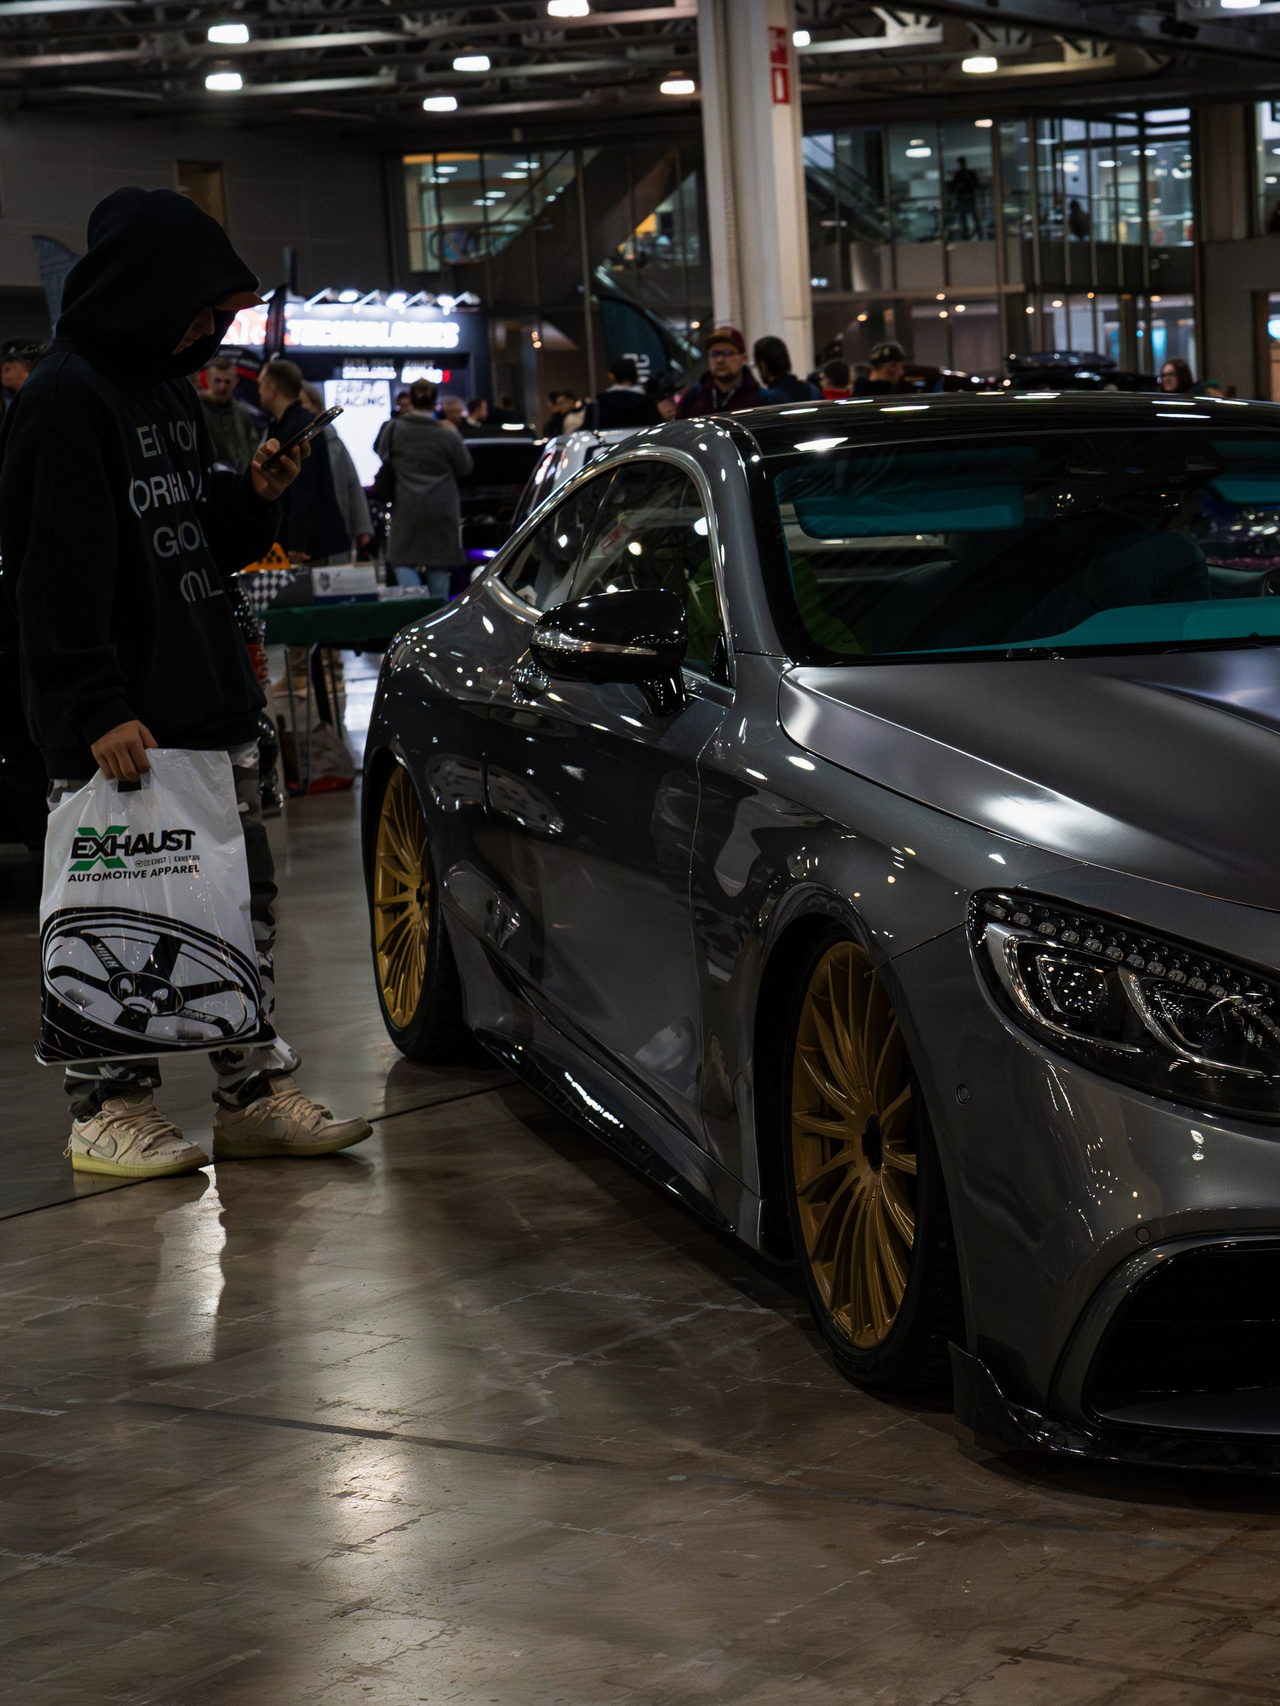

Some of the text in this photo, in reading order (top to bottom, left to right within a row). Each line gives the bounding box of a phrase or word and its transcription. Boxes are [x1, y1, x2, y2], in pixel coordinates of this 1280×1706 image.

[70, 826, 196, 862] EXHAUST
[68, 864, 200, 882] AUTOMOTIVE APPAREL
